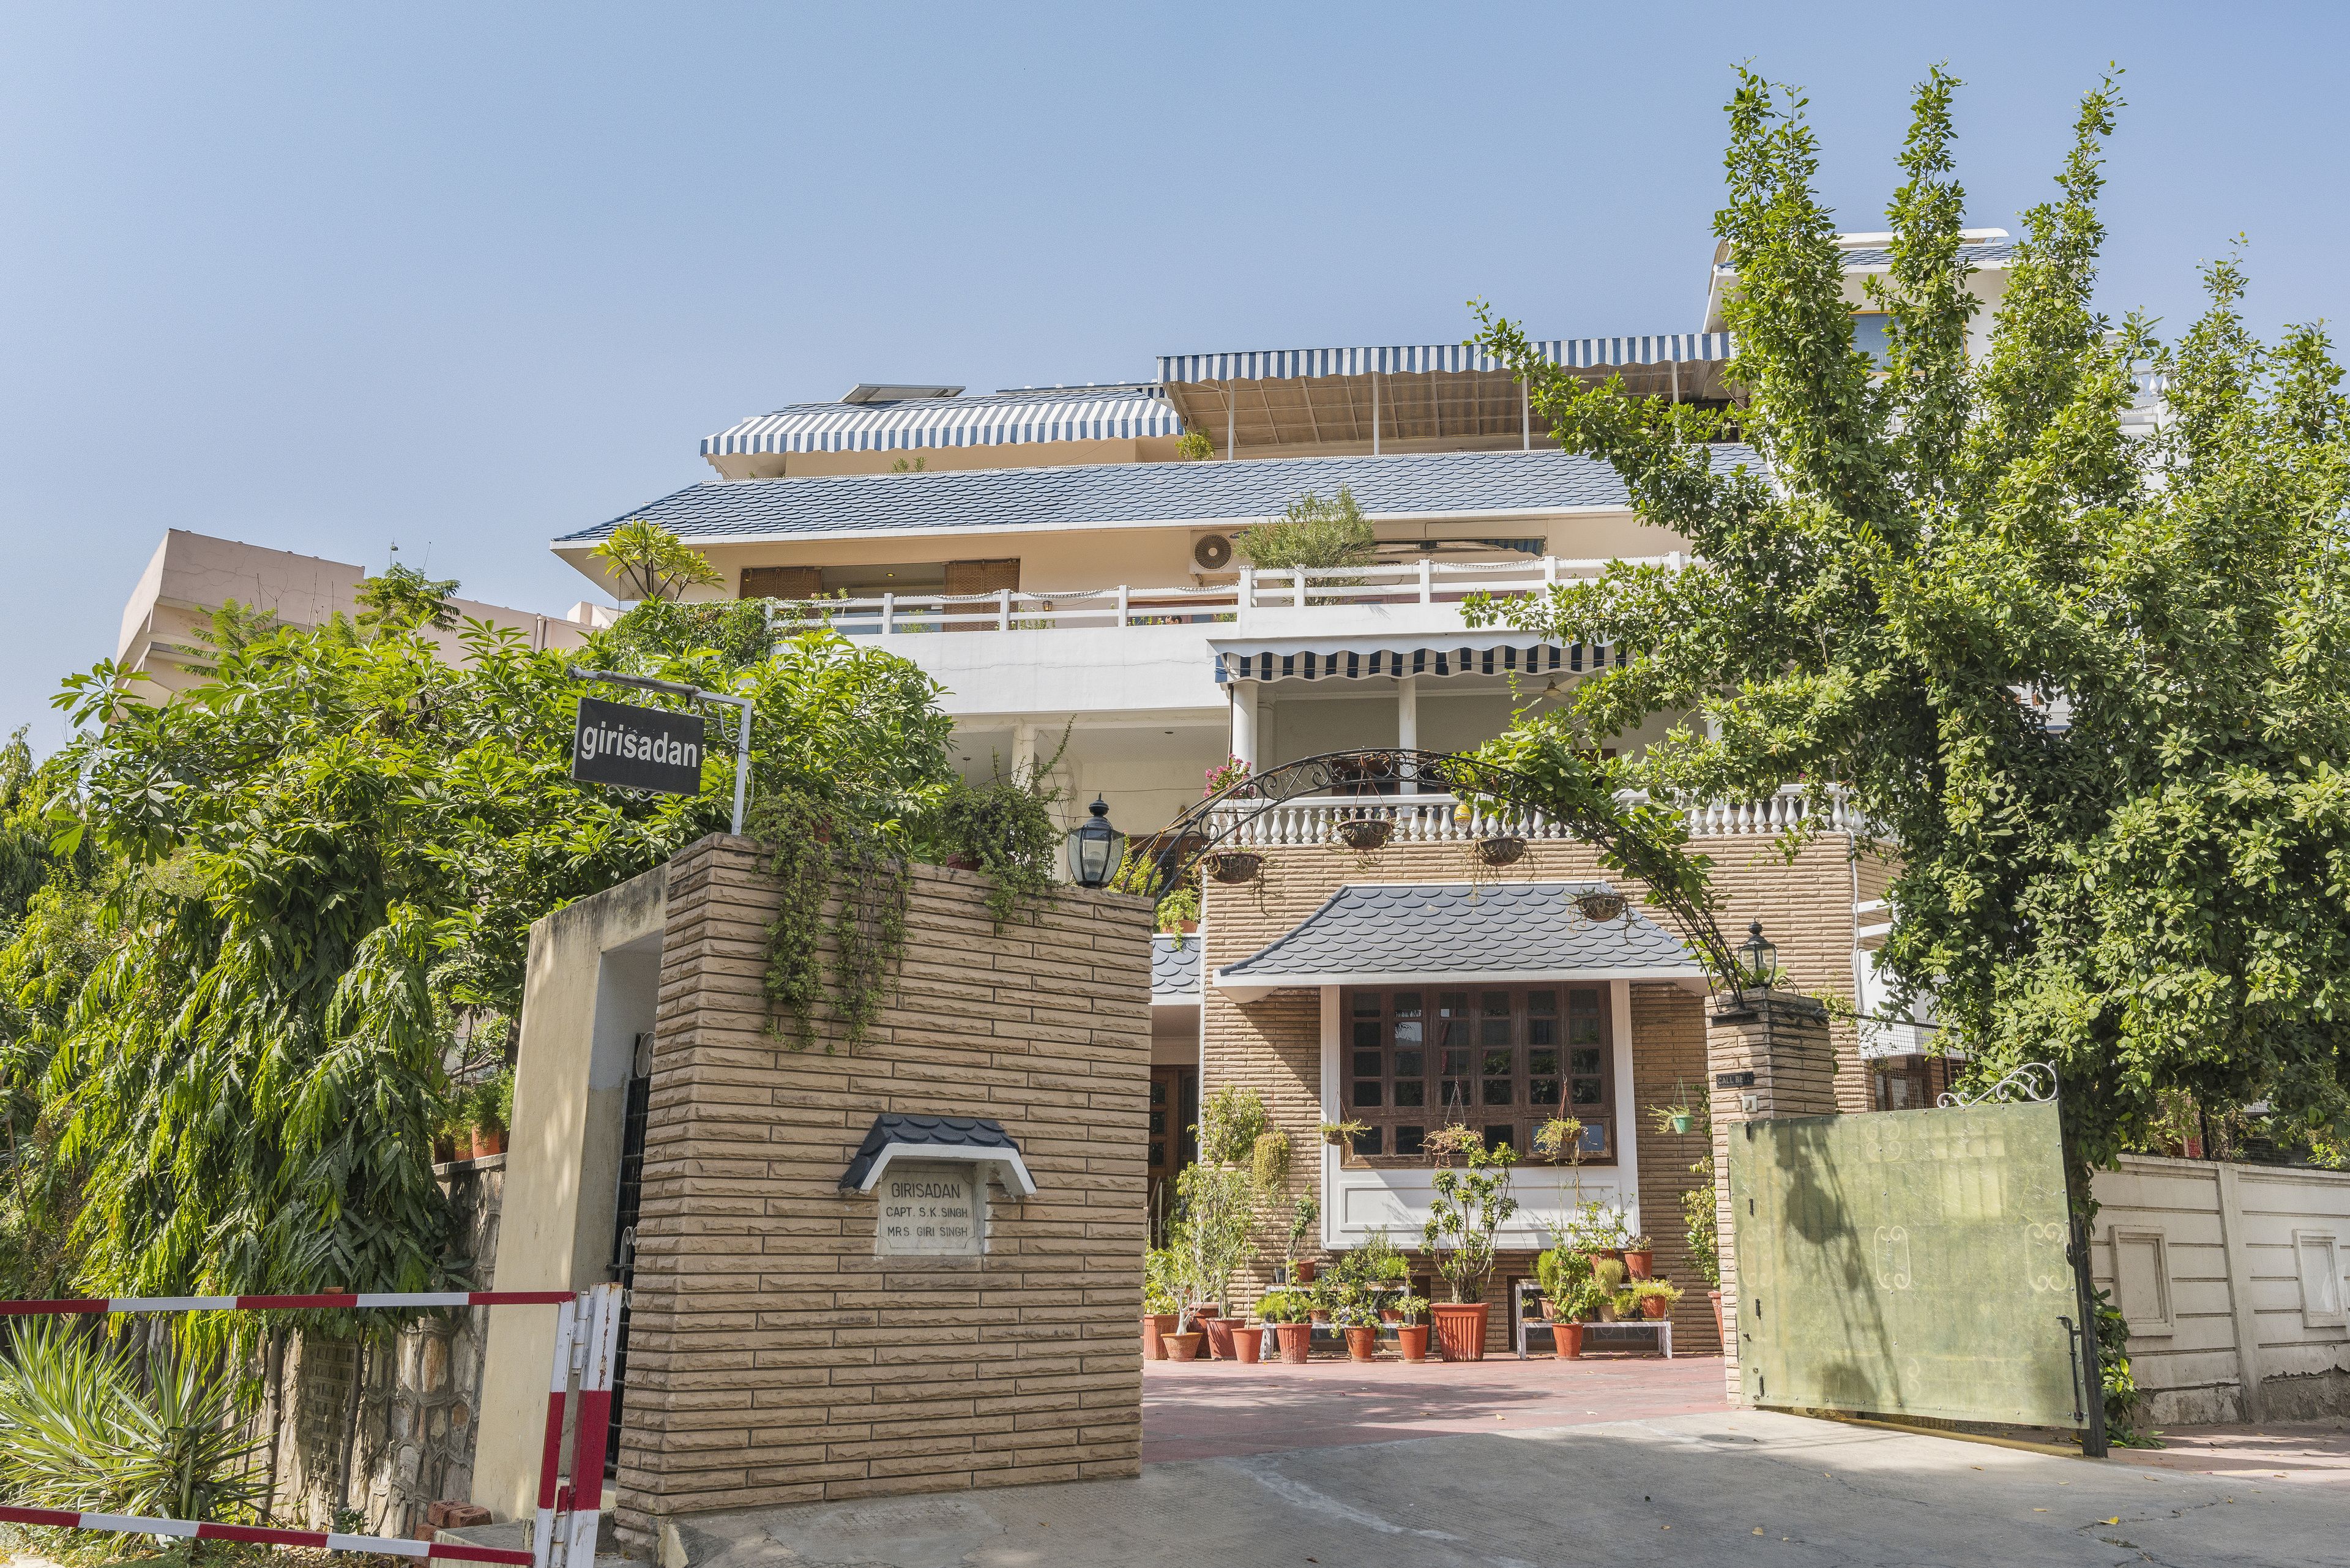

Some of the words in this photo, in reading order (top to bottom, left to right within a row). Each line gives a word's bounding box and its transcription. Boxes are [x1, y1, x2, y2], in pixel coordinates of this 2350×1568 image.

[581, 721, 697, 767] girisadan
[1717, 1076, 1734, 1085] CALL
[891, 1182, 960, 1198] GIRISADAN
[886, 1207, 916, 1217] CAPT.
[887, 1226, 912, 1237] MRS.
[916, 1226, 934, 1237] GIRI
[939, 1226, 968, 1237] SINGH
